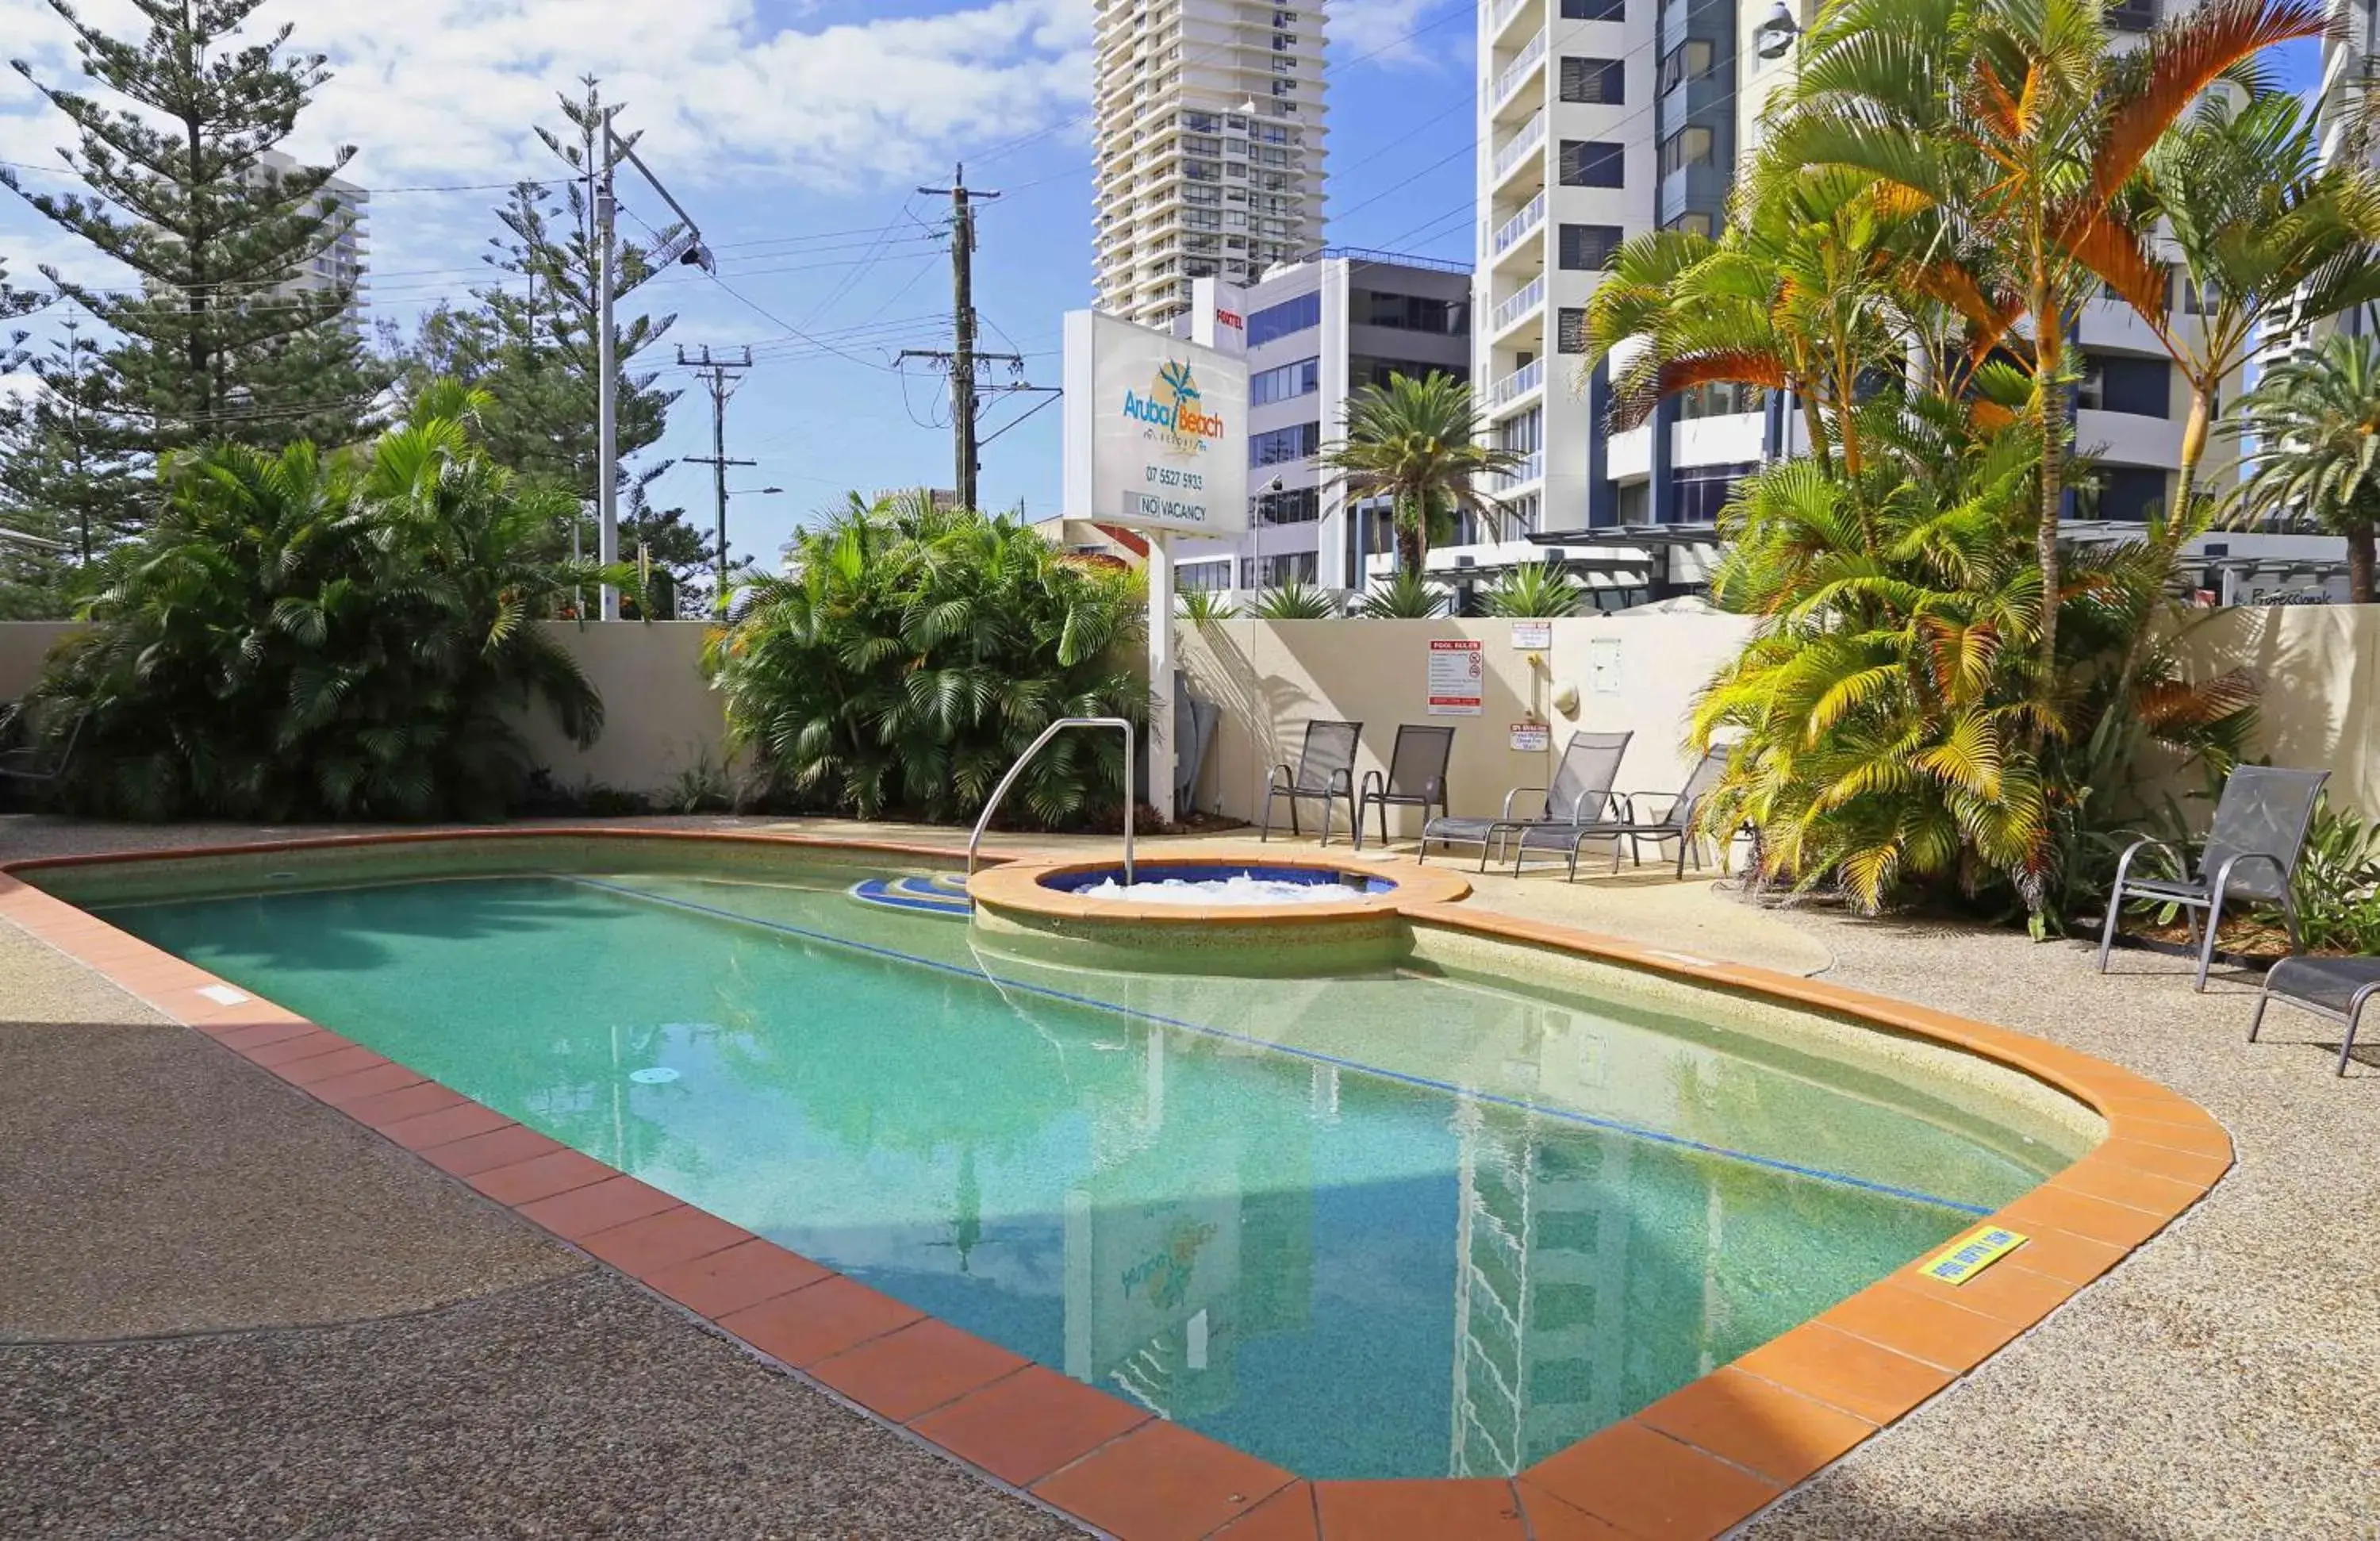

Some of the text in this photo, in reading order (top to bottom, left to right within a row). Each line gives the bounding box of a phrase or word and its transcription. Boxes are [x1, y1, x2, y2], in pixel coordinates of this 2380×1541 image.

[1217, 309, 1242, 330] FOXTEL
[1123, 390, 1223, 438] Aruba Beach
[1146, 466, 1157, 482] 07
[1160, 468, 1180, 486] 5527
[1142, 498, 1207, 521] NO VACANCY
